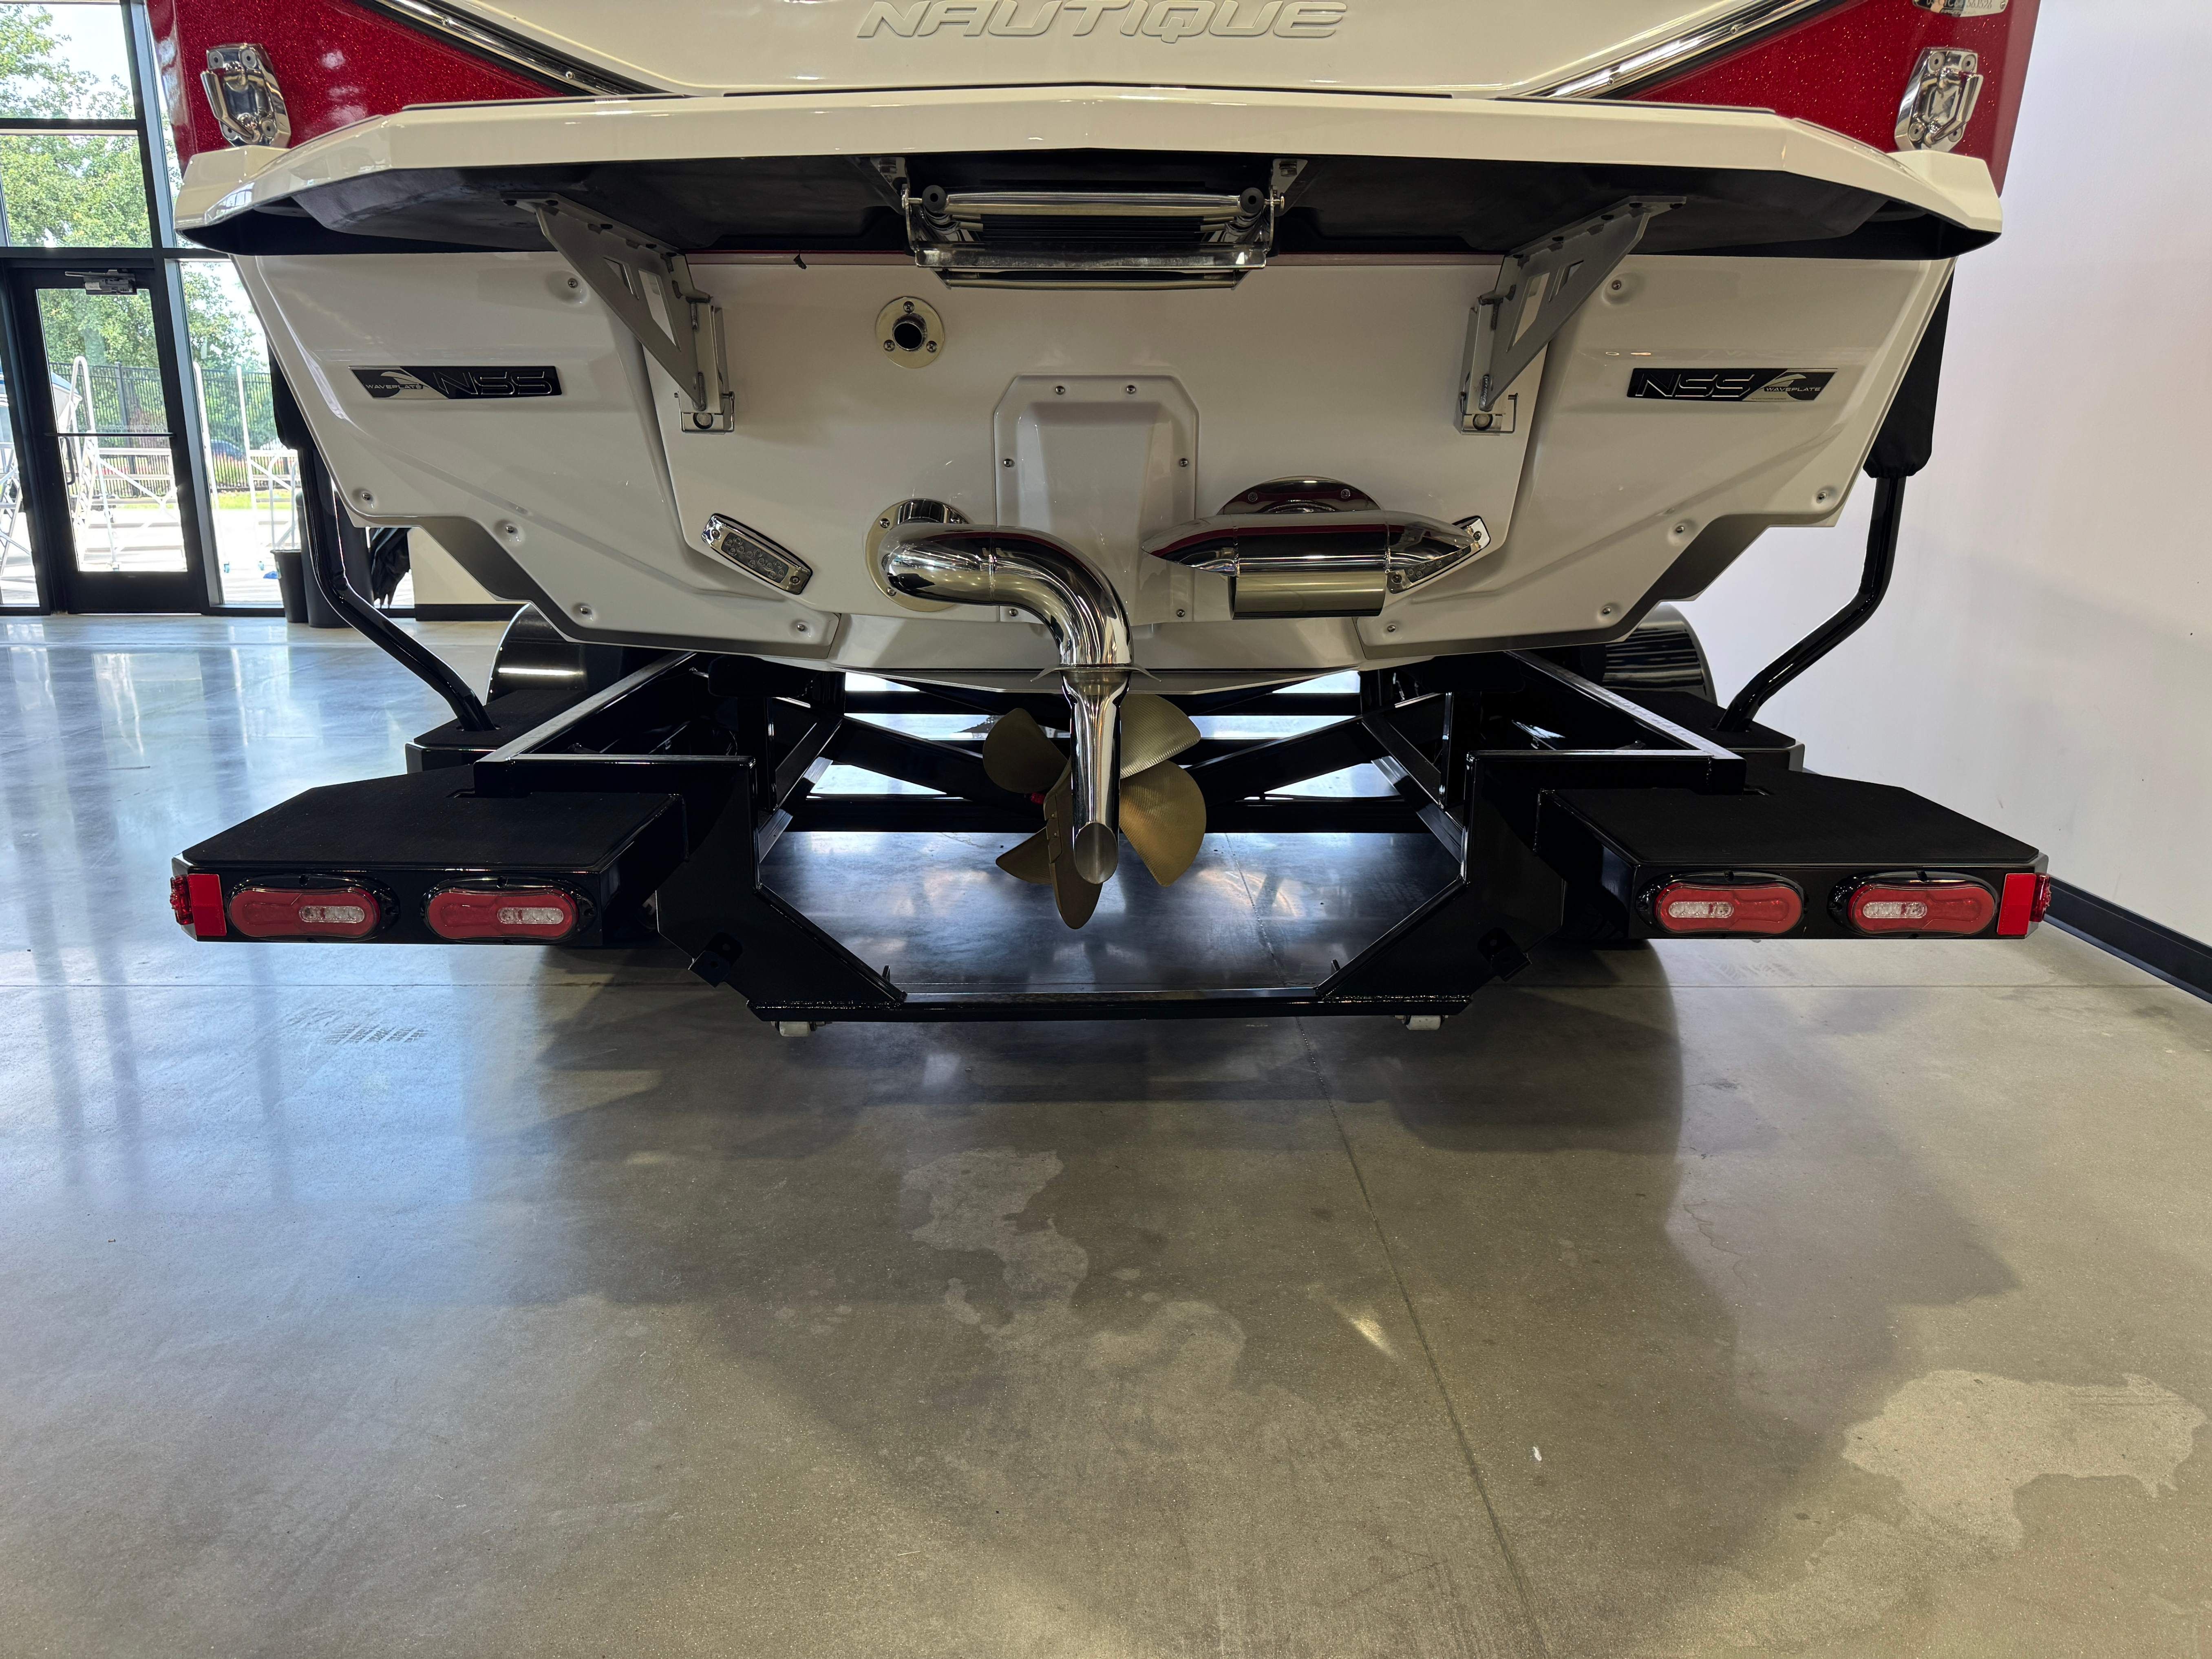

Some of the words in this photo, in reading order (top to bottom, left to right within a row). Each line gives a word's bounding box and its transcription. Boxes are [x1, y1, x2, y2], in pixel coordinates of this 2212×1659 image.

[857, 1, 1347, 43] NAUTIQUE
[433, 371, 552, 395] NSS
[1635, 373, 1755, 397] NSS
